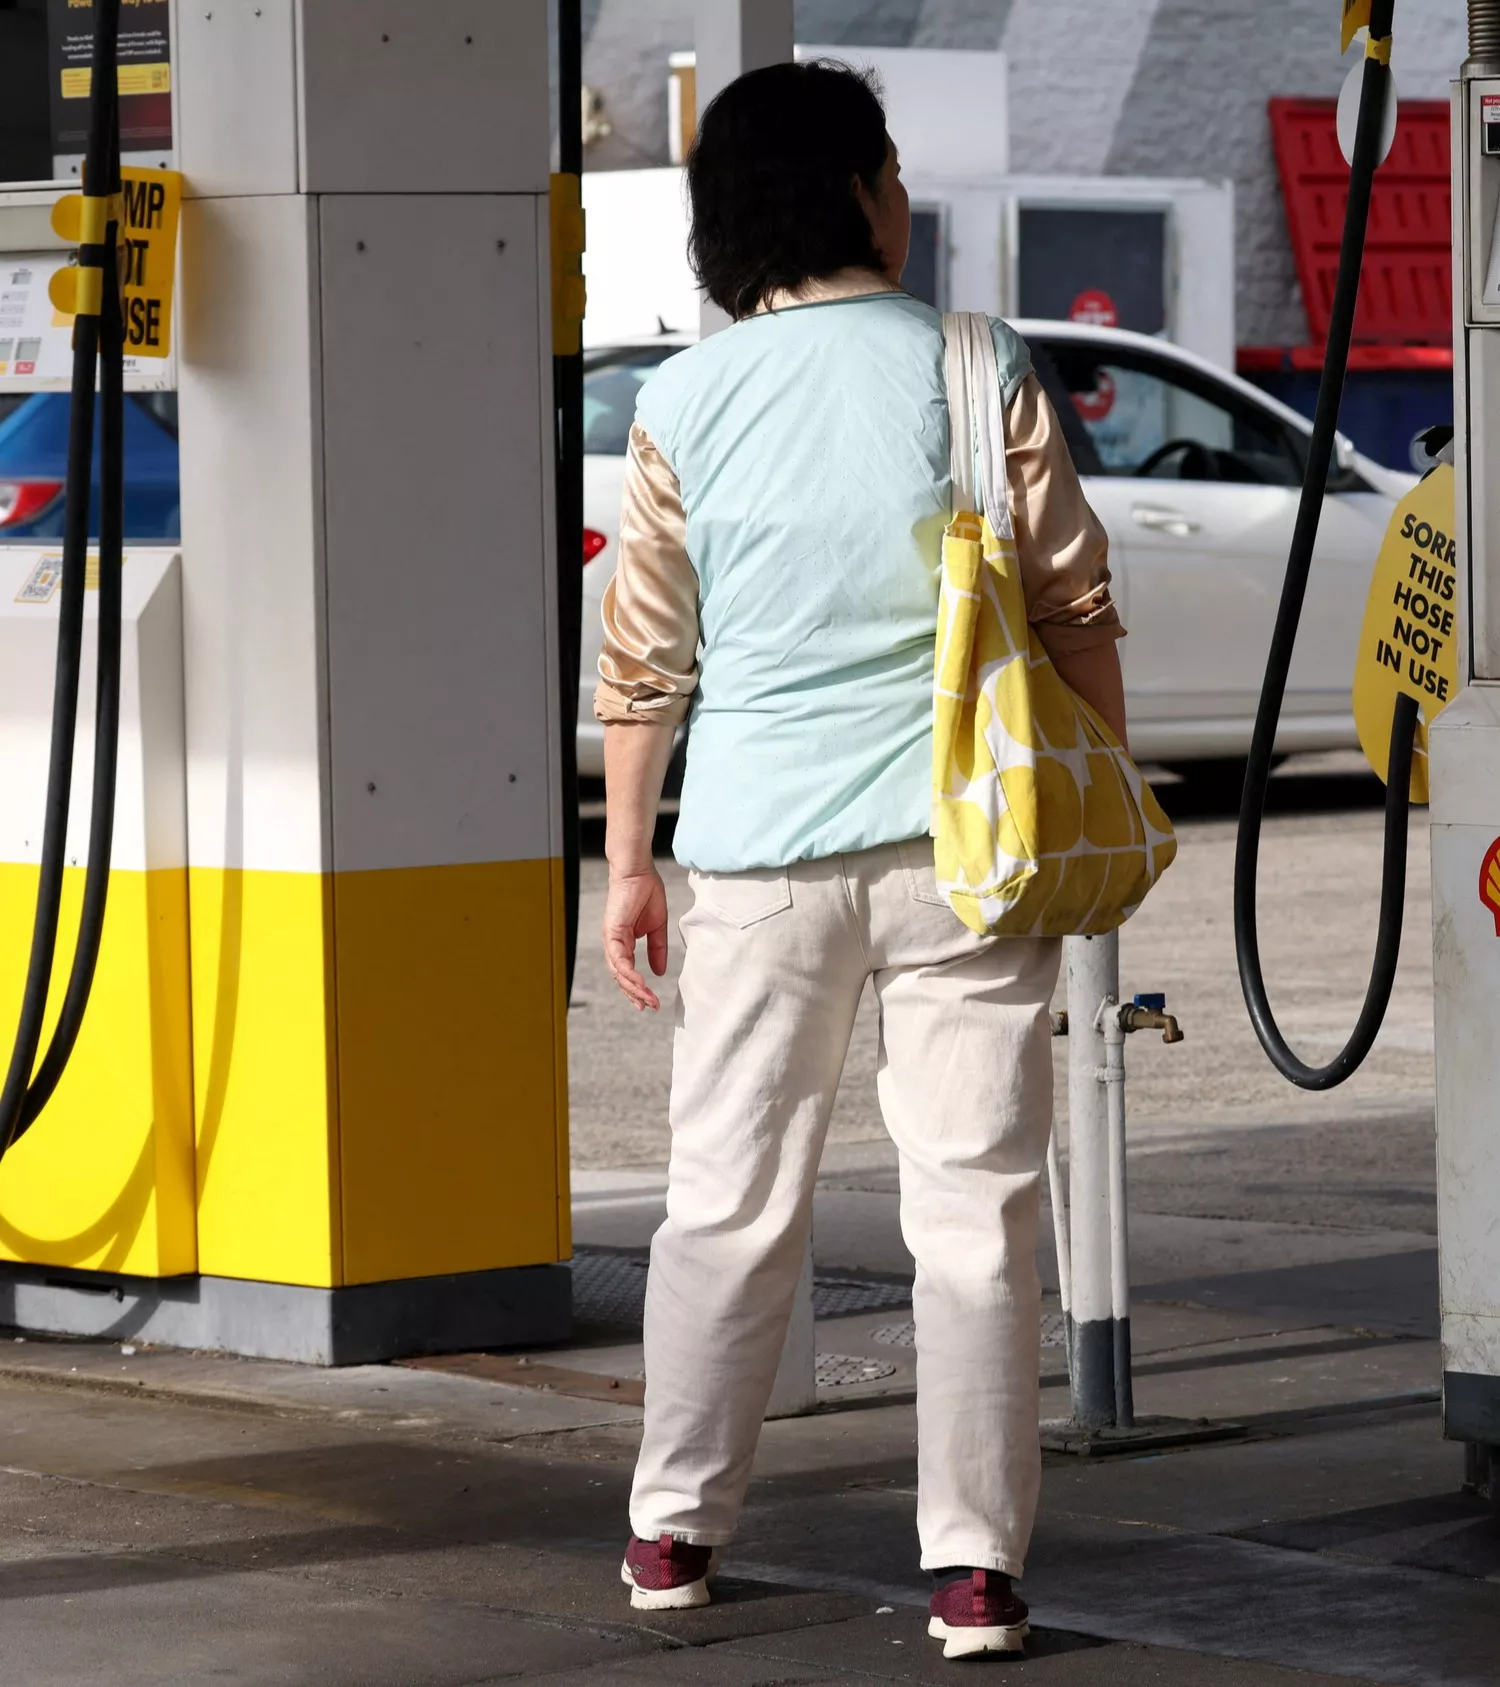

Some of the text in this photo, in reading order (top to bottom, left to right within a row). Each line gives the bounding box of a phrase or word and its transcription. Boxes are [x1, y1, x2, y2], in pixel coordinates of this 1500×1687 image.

[124, 180, 165, 229] MP
[1400, 513, 1456, 568] SORR
[1408, 552, 1456, 601] THIS
[1393, 581, 1454, 637] HOSE
[1393, 616, 1443, 663] NOT
[1376, 639, 1449, 702] IN USE
